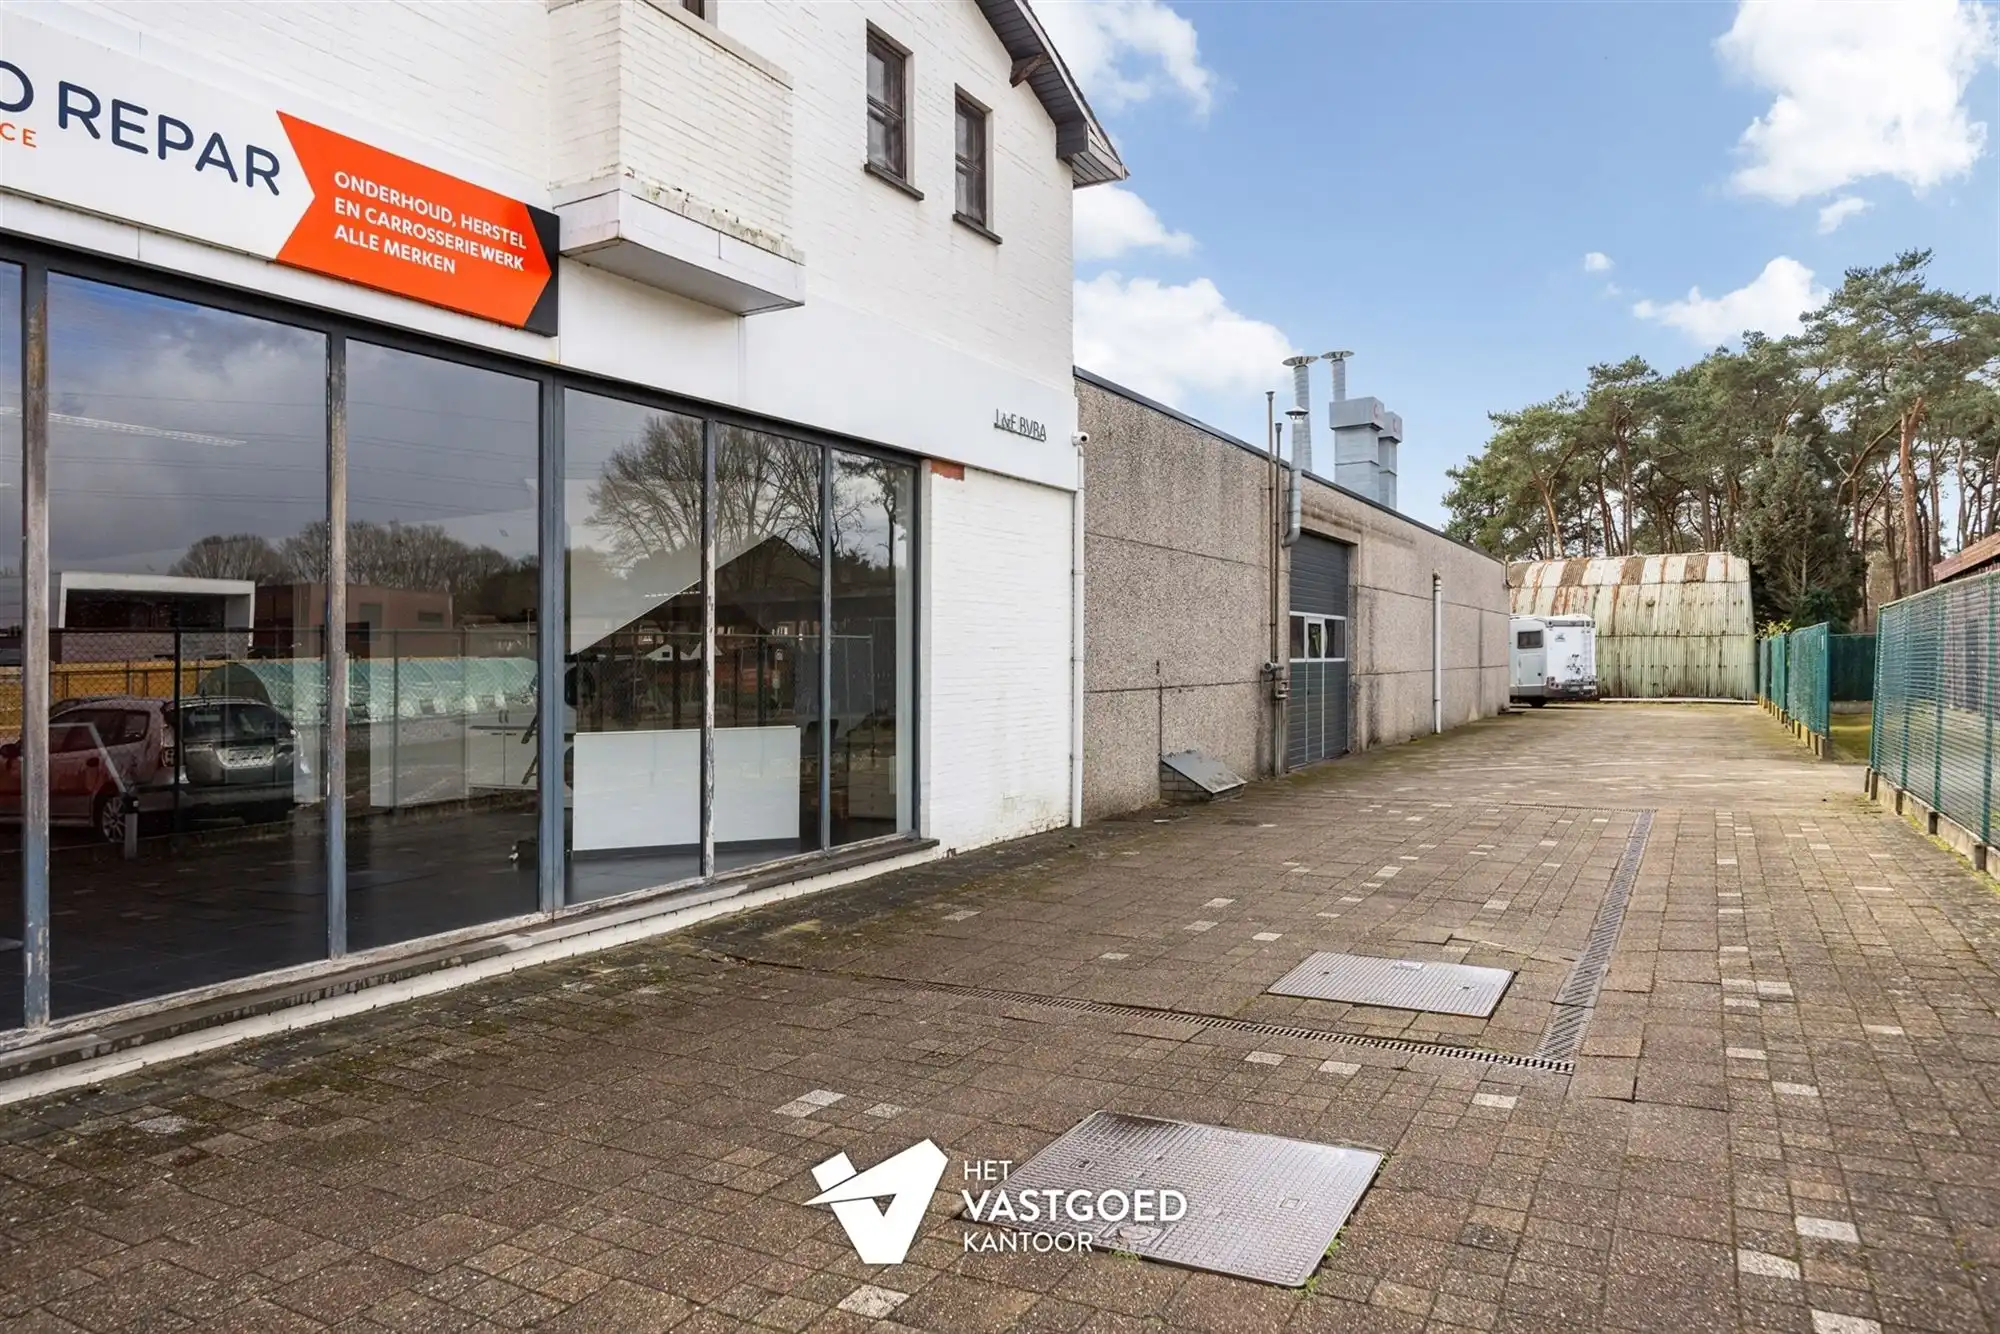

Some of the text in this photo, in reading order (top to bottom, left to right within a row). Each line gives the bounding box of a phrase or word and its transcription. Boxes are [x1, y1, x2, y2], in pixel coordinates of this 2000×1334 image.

[58, 80, 280, 196] REPAR
[334, 171, 527, 250] ONDERHOUD, HERSTEL
[334, 196, 524, 271] EN CARROSSERIEWERK
[334, 224, 456, 274] ALLE MERKEN
